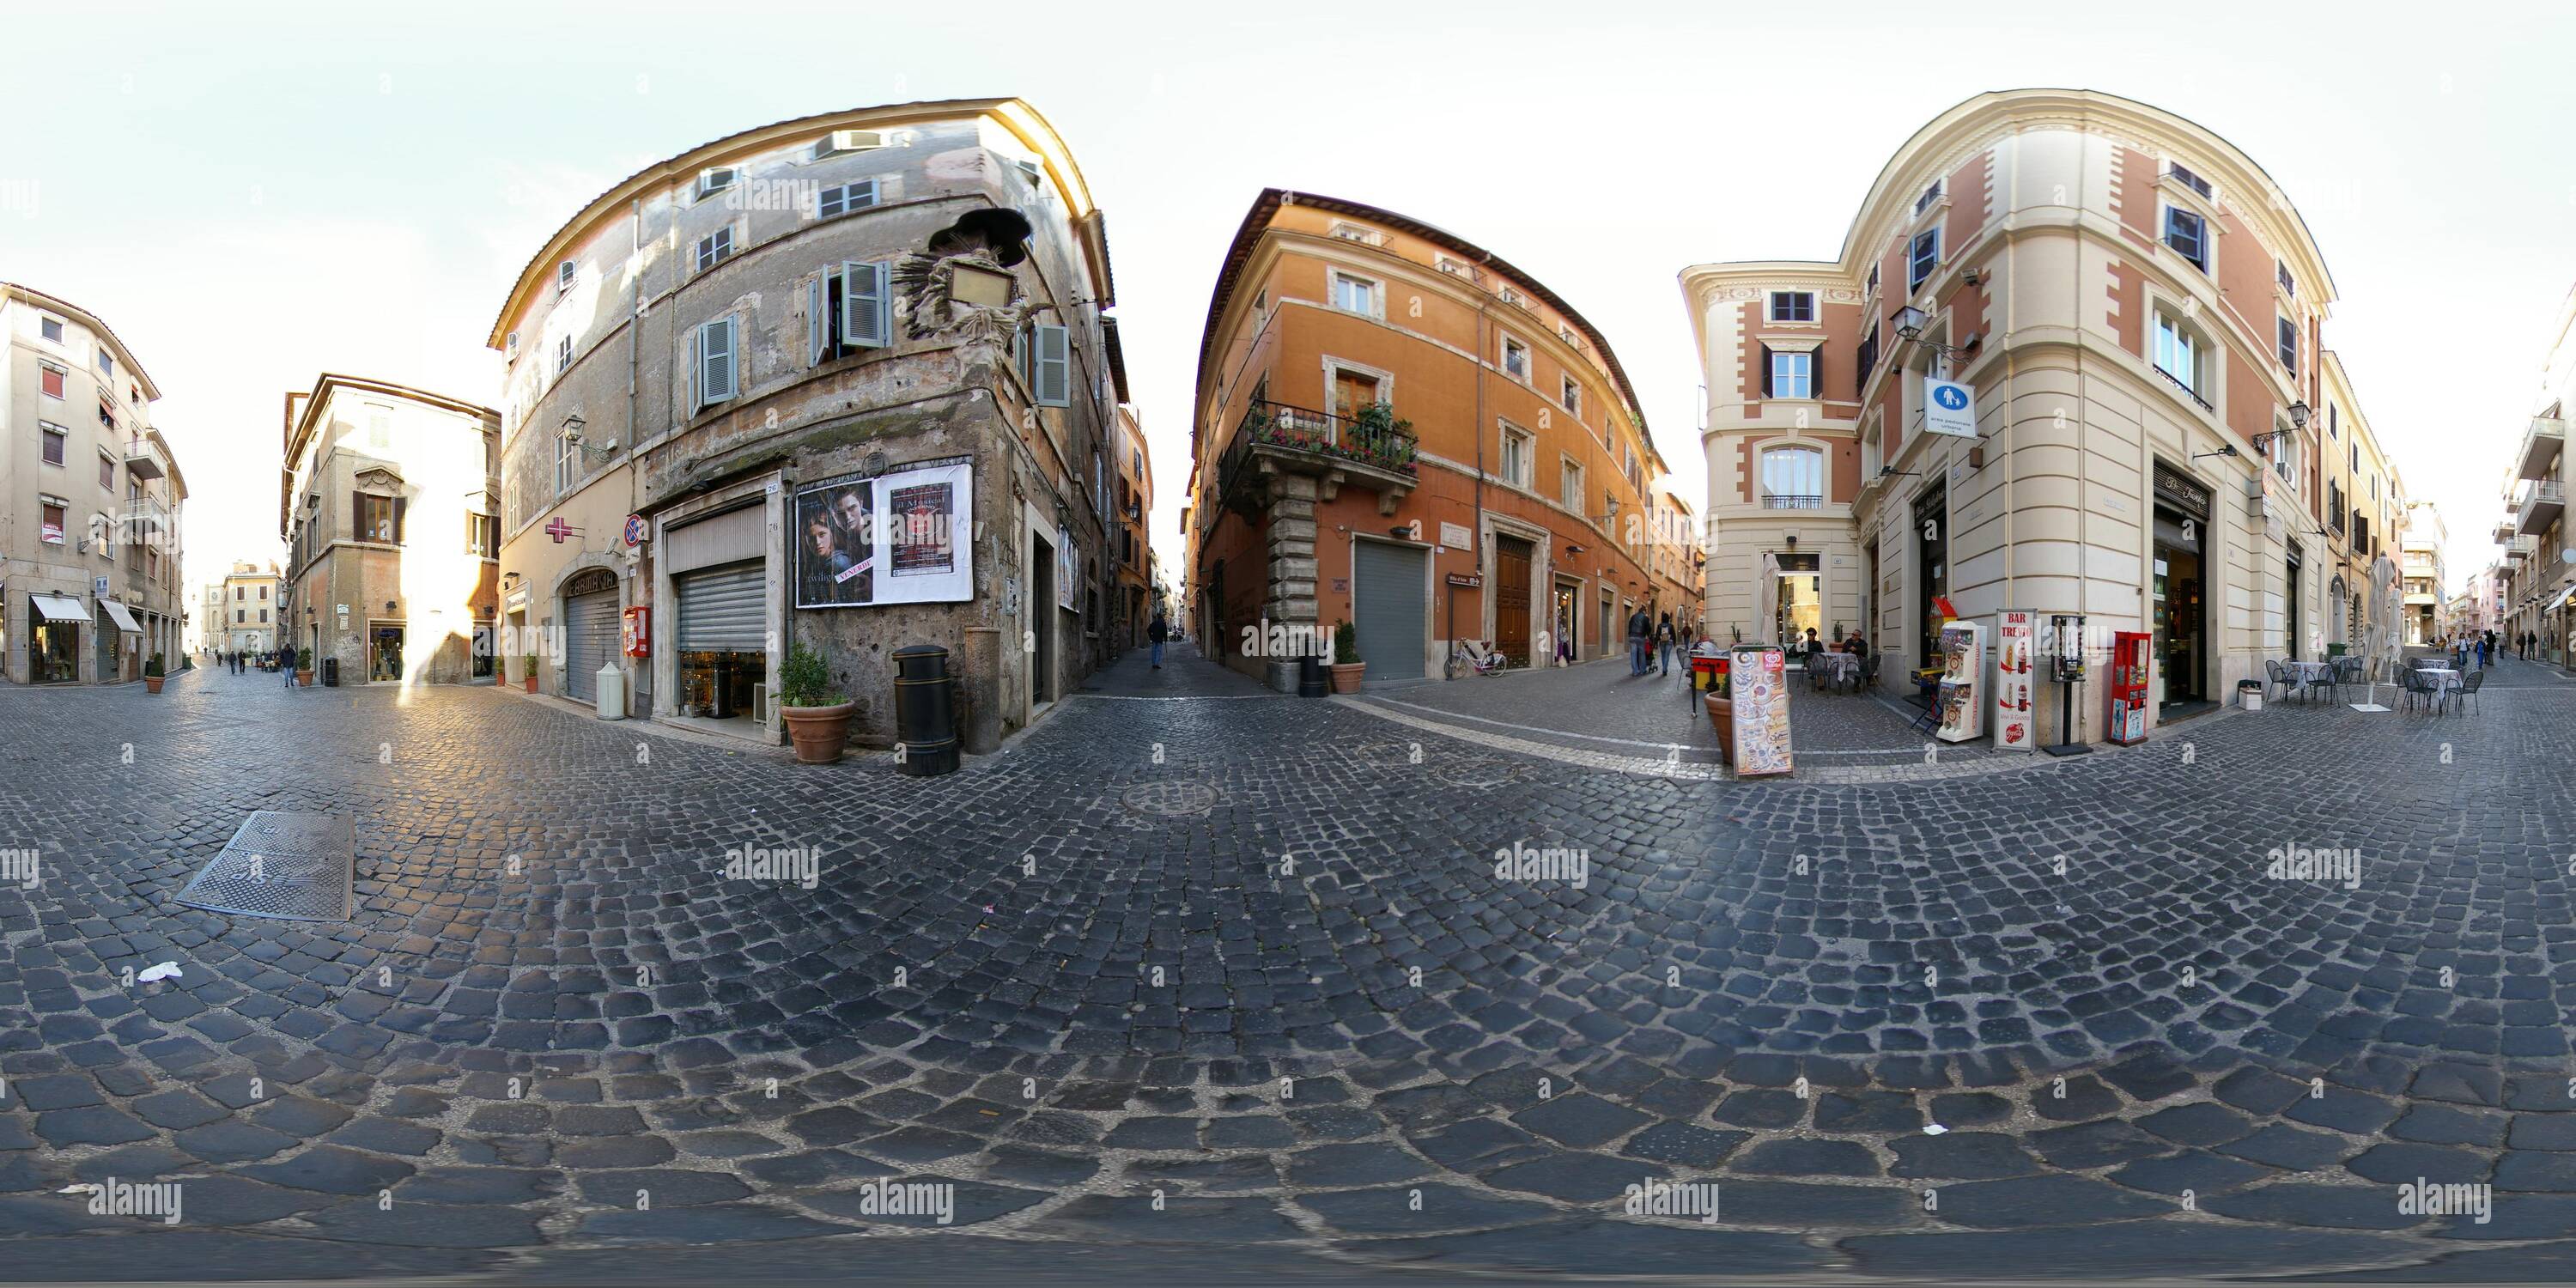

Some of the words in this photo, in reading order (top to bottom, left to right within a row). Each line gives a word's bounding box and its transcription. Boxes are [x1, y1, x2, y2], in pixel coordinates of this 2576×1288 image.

[823, 473, 862, 488] ADRIANA
[768, 483, 776, 493] 76
[769, 522, 779, 533] 76
[2008, 613, 2026, 623] BAR
